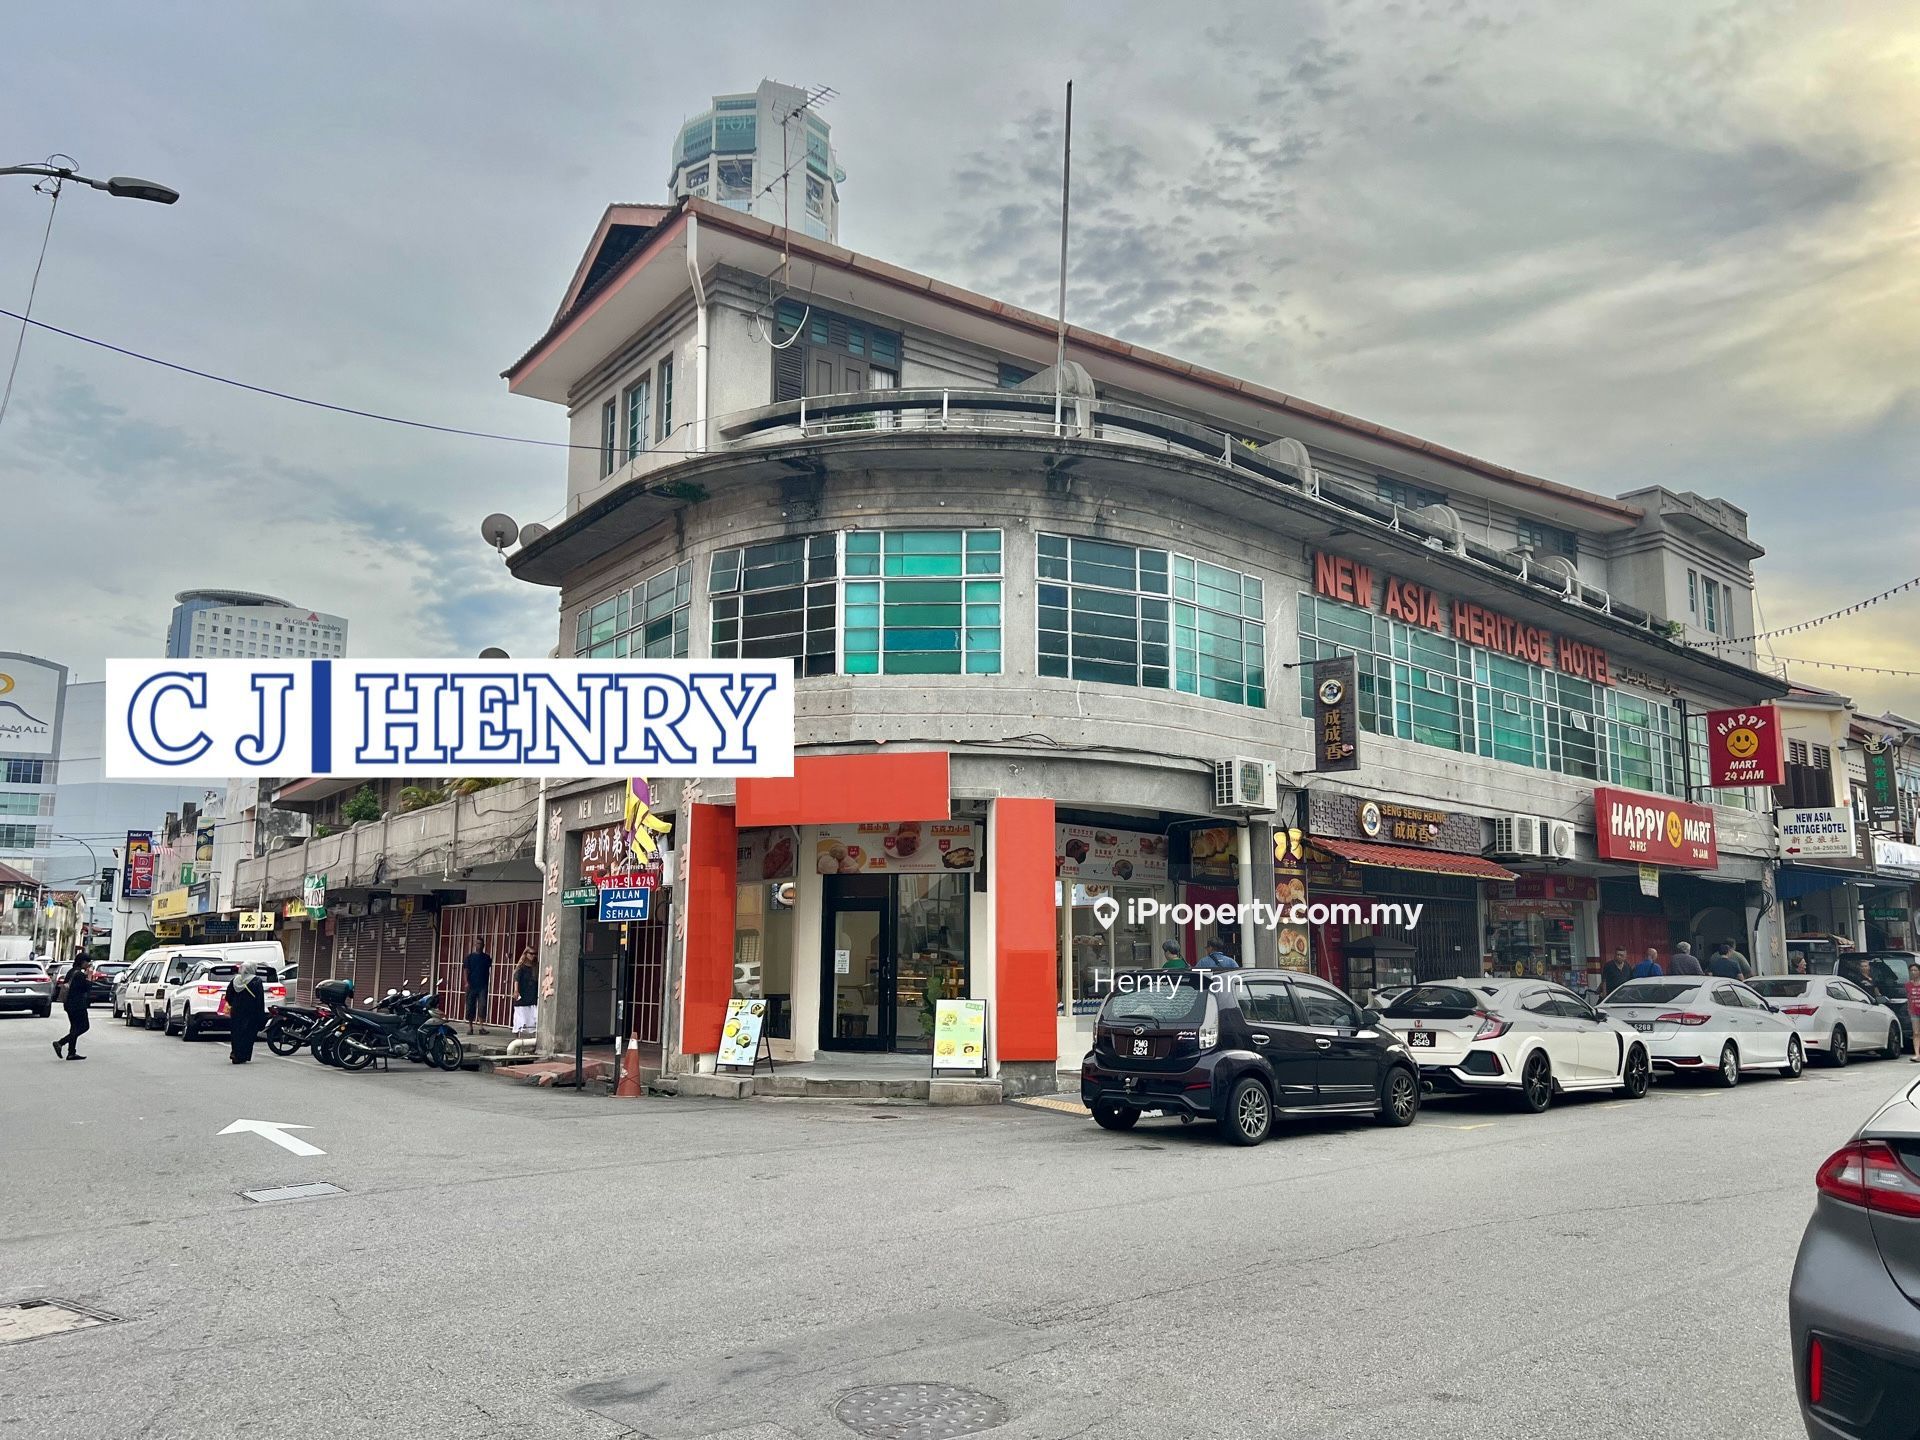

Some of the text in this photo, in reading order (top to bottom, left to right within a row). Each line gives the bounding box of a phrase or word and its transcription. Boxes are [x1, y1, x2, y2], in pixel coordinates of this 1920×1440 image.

[1314, 551, 1373, 609] NEW
[1384, 576, 1443, 633] ASIA
[1453, 599, 1553, 668] HERITAGE
[1558, 635, 1617, 687] HOTEL
[311, 621, 341, 632] Wembley
[11, 725, 48, 734] MALL
[1717, 713, 1767, 736] HAPPY
[1324, 709, 1344, 760] 成成香
[1729, 760, 1758, 770] MART
[1724, 769, 1764, 781] 24 JAM
[578, 792, 620, 819] NEW ASIA
[1382, 804, 1447, 824] SENG SENG HEANG
[1796, 812, 1832, 823] NEW ASIA
[1611, 802, 1711, 845] HAPPY MART
[1784, 823, 1847, 835] HERITAGE HOTEL
[1629, 840, 1647, 853] 24 HRS
[1692, 848, 1709, 859] 24 JAM
[564, 890, 575, 899] JALAN
[610, 890, 640, 900] JALAN
[605, 911, 642, 919] SEHALA
